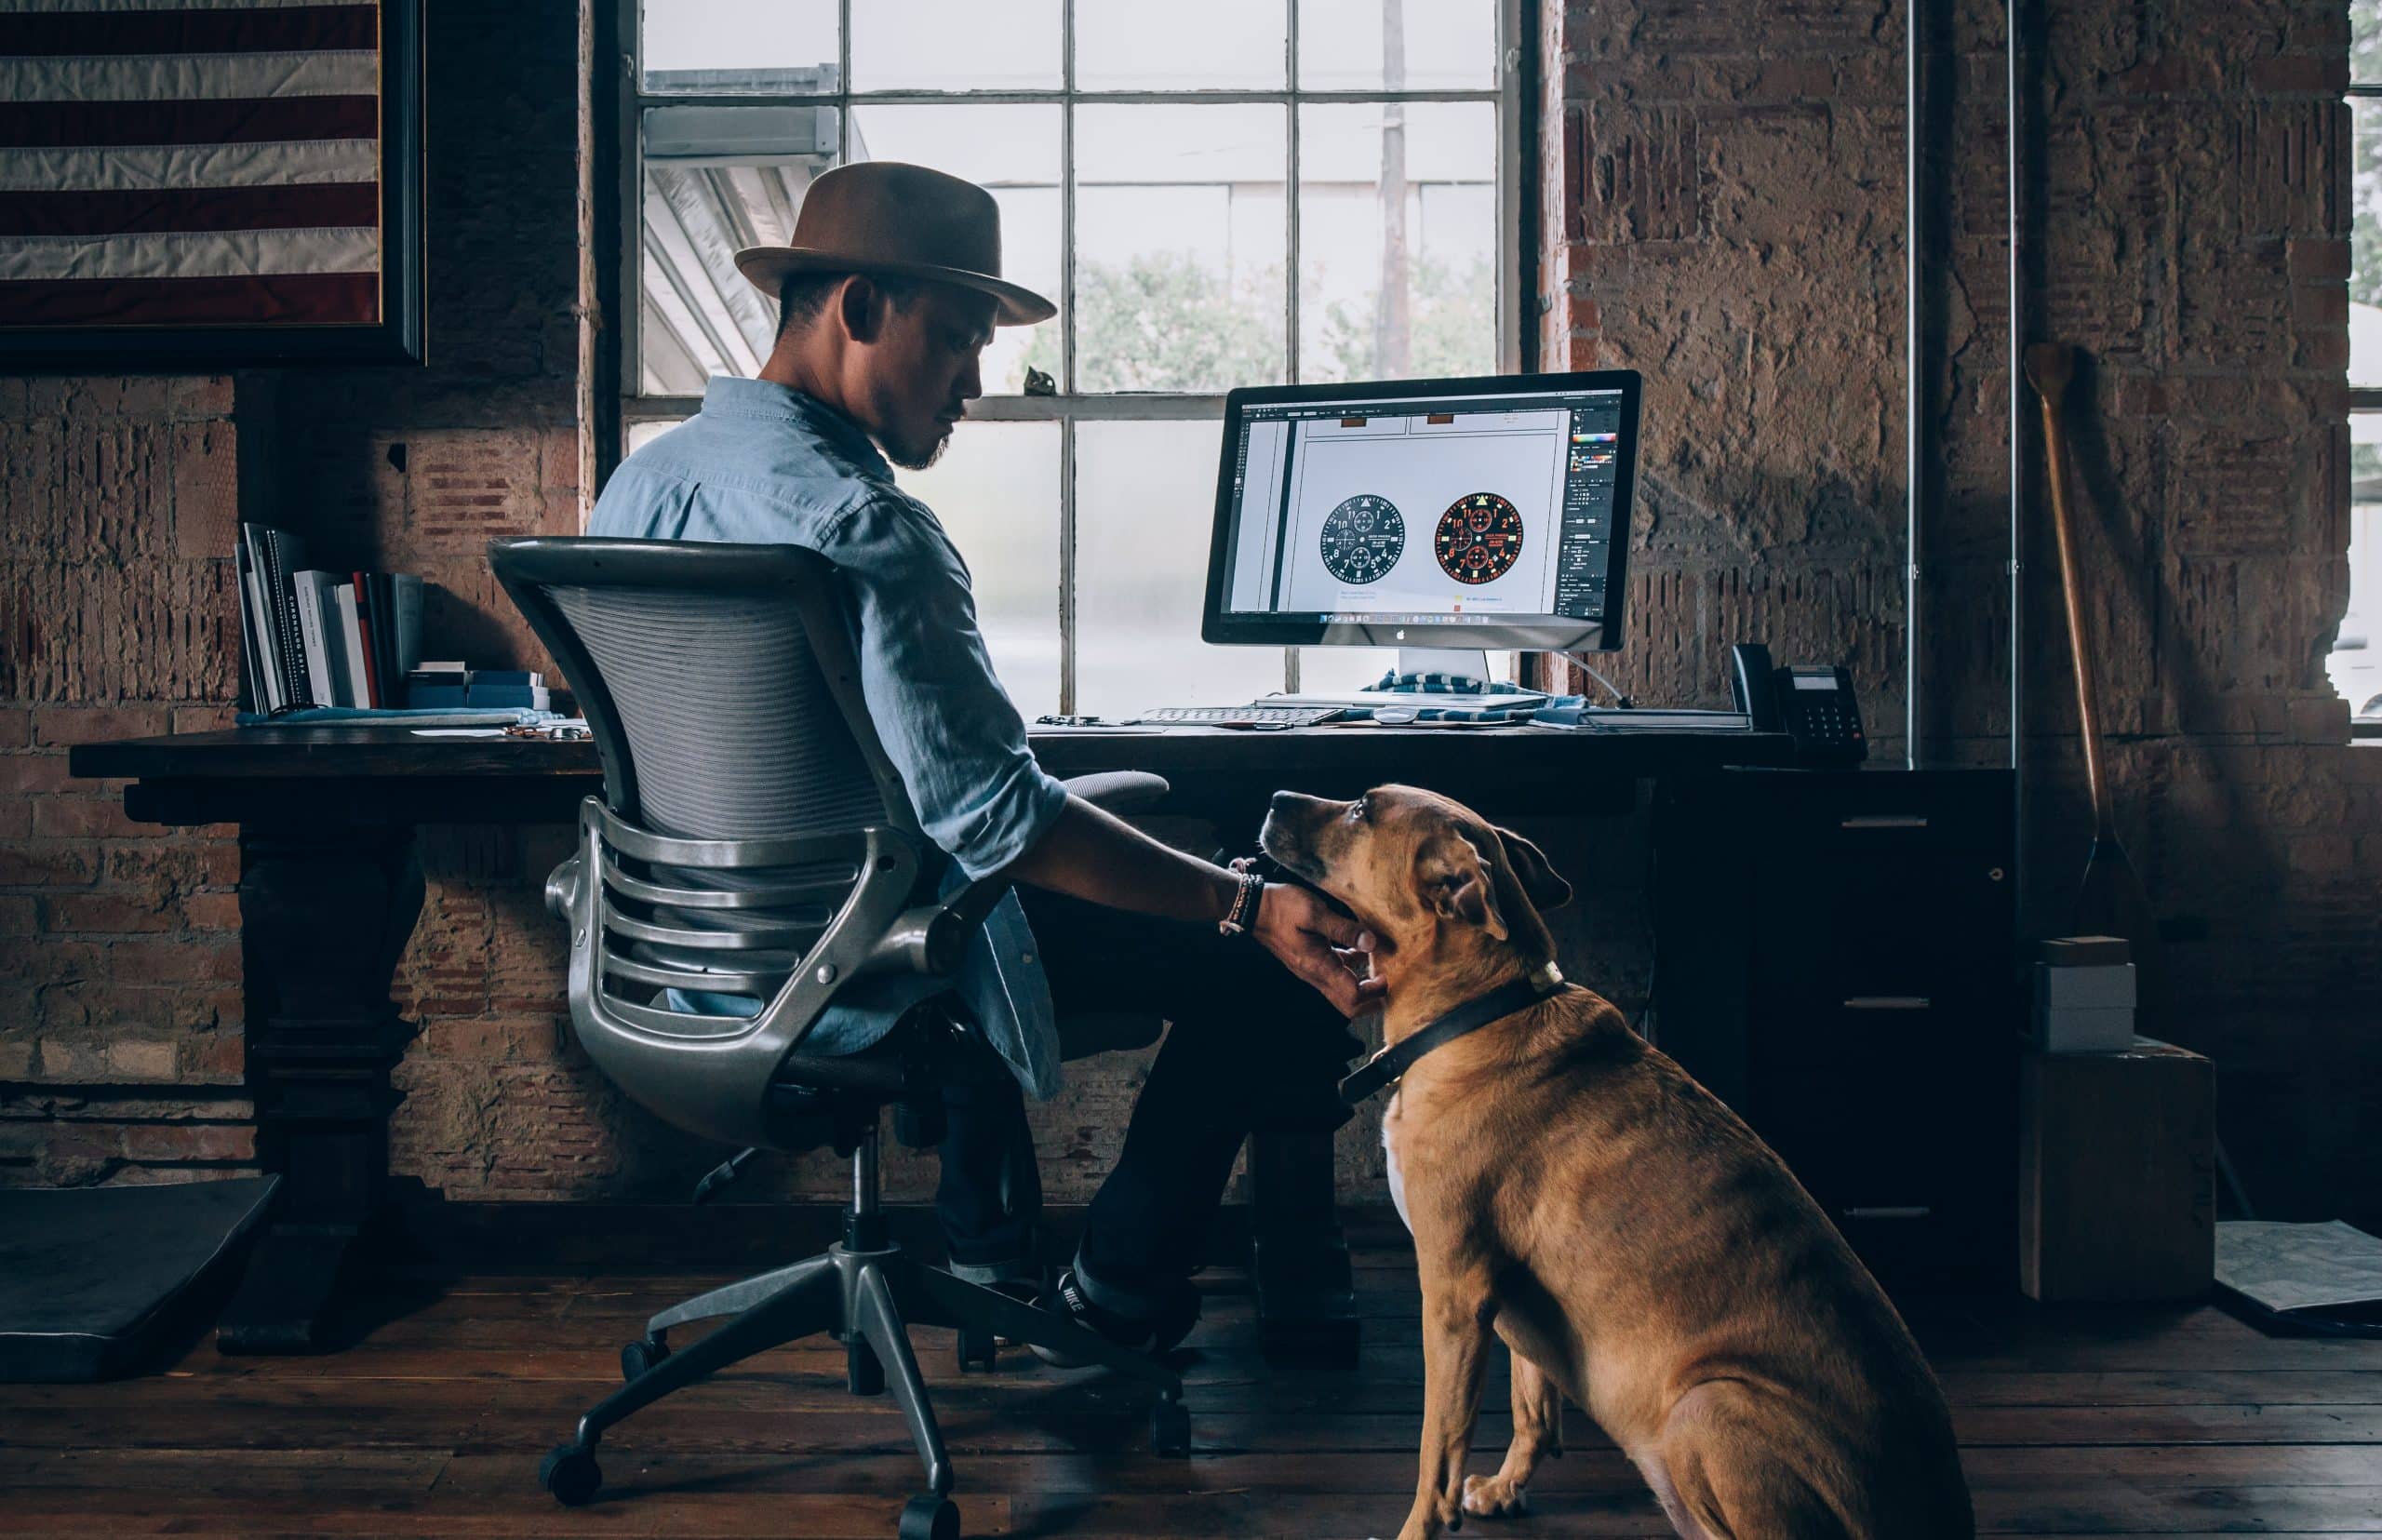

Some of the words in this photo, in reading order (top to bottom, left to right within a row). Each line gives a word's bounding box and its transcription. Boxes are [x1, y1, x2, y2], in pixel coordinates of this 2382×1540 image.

[1348, 511, 1356, 519] 11
[1463, 509, 1471, 518] 11
[1338, 521, 1347, 529] 10
[1384, 520, 1390, 529] 2
[1452, 519, 1463, 528] 10
[1502, 519, 1508, 528] 2
[1333, 550, 1340, 558] 8
[1449, 548, 1455, 557] 8
[1499, 548, 1505, 556] 4
[1344, 560, 1349, 569] 7
[1371, 560, 1376, 569] 5
[1459, 559, 1465, 569] 7
[1488, 559, 1494, 569] 5
[289, 596, 301, 649] CHRONOLOG
[1064, 1287, 1085, 1312] NIKE
